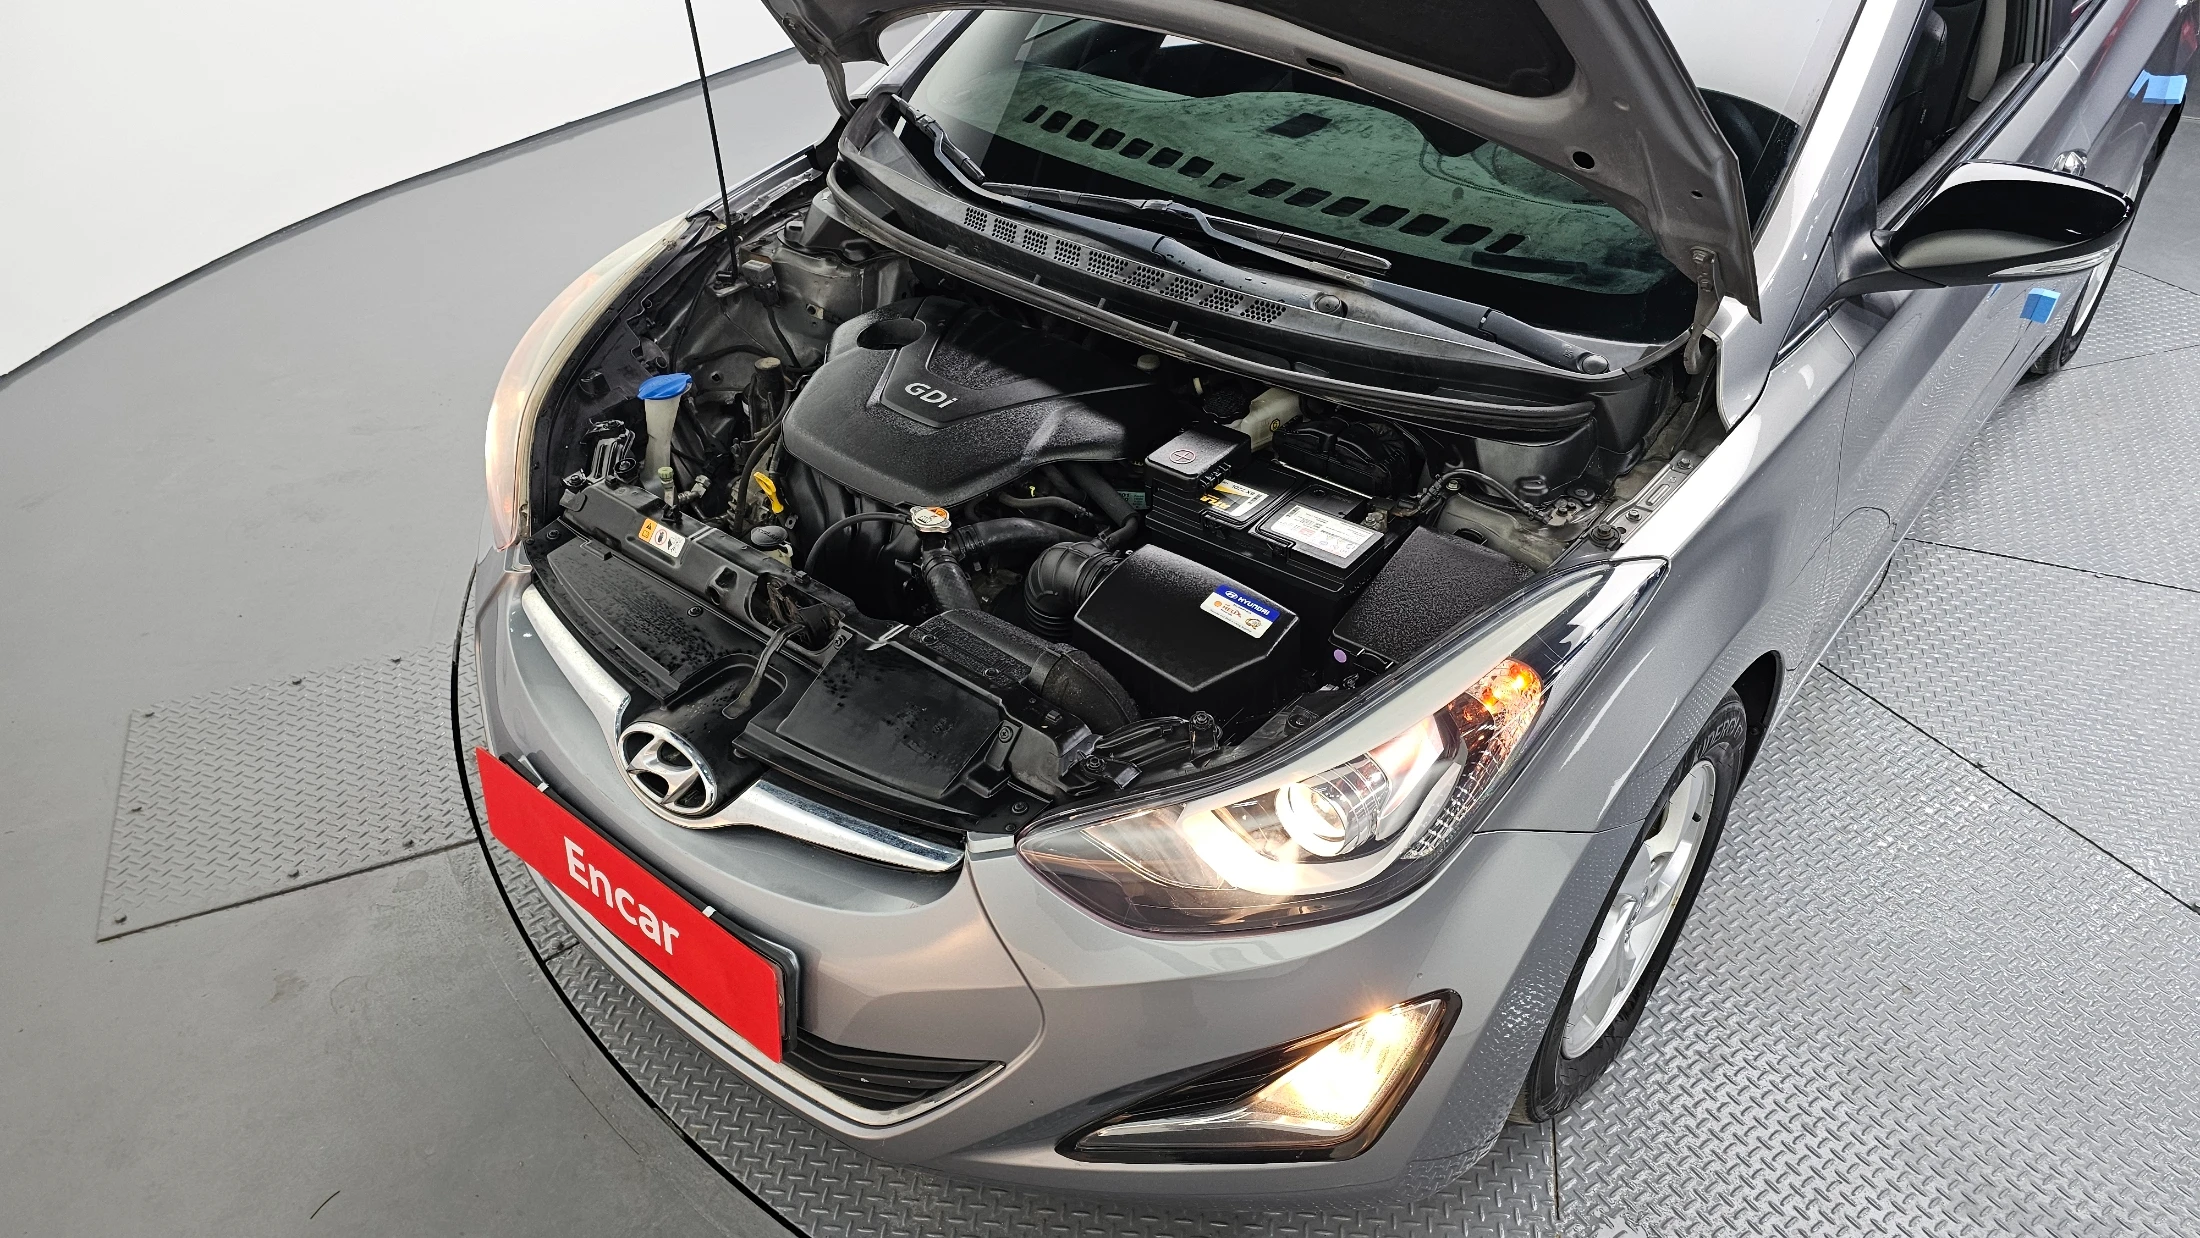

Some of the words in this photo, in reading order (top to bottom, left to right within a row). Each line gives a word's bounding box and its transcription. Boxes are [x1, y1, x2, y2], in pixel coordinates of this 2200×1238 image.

[905, 382, 958, 408] GDi
[1237, 596, 1271, 616] HYUNDAI
[564, 835, 680, 956] Encar
